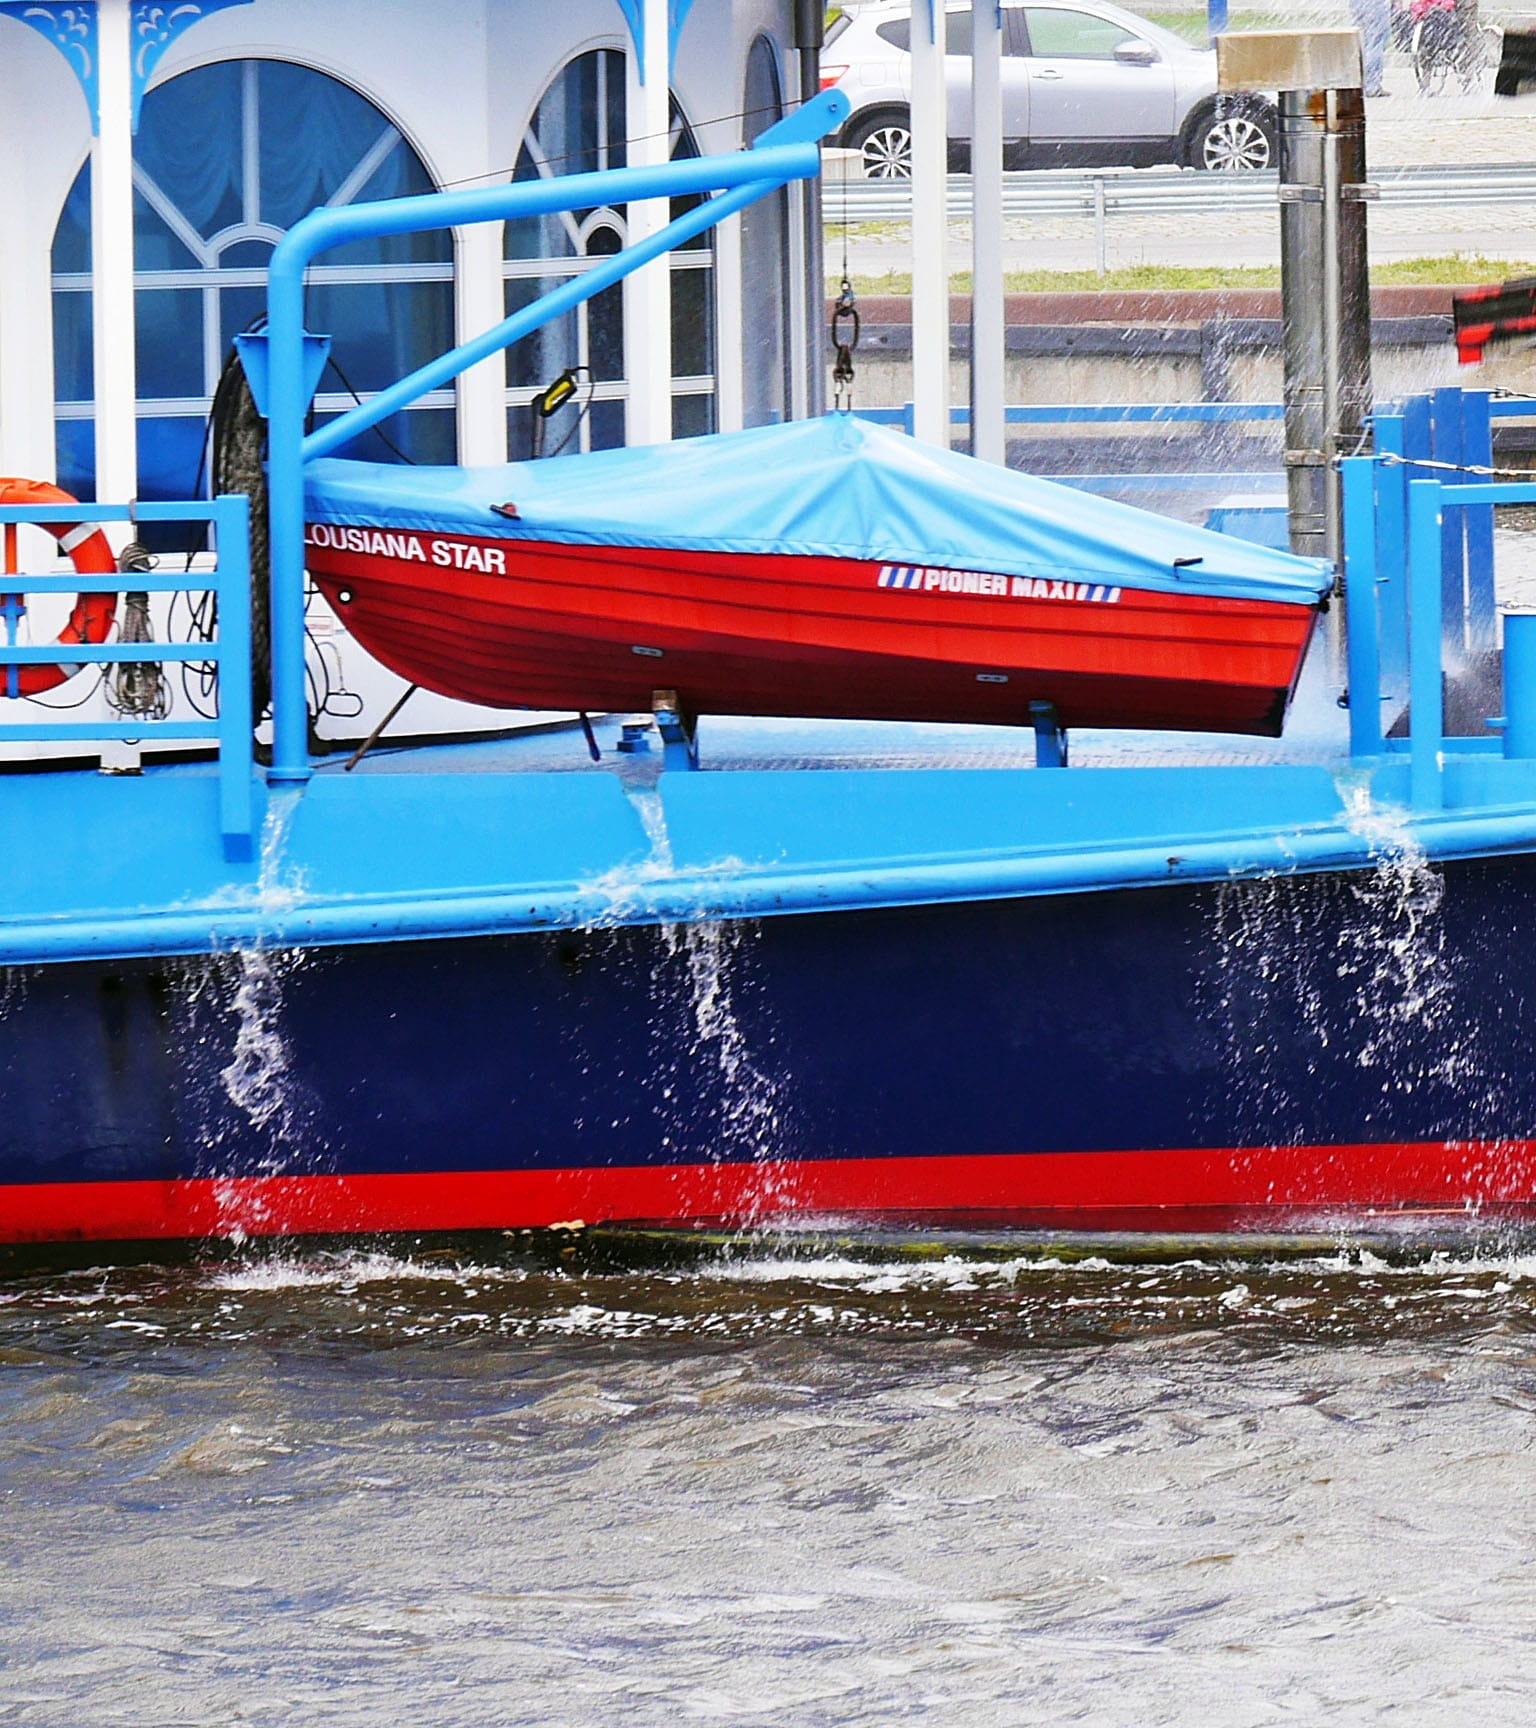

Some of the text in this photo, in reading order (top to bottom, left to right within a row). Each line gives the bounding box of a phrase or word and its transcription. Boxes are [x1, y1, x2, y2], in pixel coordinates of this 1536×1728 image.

[431, 541, 507, 575] STAR
[924, 569, 1075, 600] PIONER MAXI
